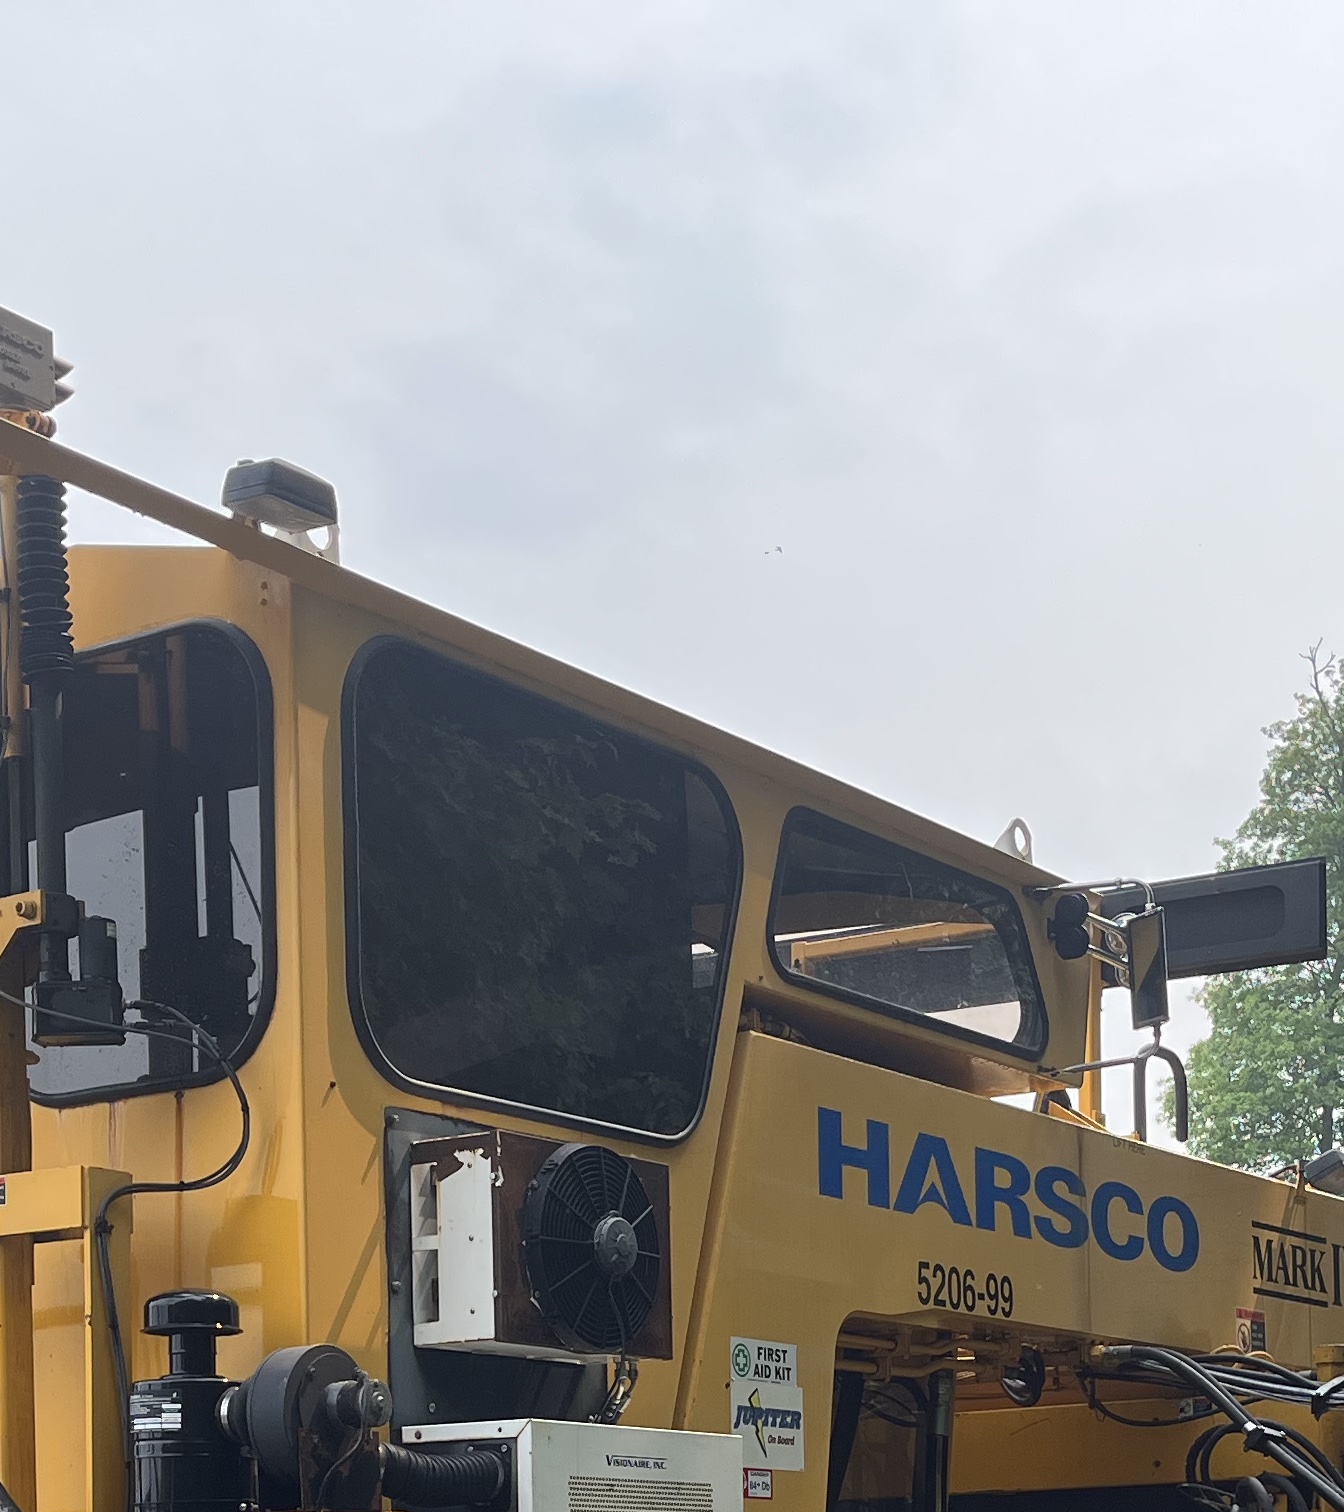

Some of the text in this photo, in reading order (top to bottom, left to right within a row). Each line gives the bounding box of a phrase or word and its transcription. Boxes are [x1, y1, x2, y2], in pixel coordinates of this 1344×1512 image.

[817, 1106, 1200, 1272] HARSCO
[1251, 1234, 1329, 1294] MARK
[917, 1260, 1014, 1319] 5206-99
[757, 1345, 788, 1364] FIRST
[752, 1363, 792, 1381] AID KIT
[733, 1404, 802, 1430] JUPITER
[767, 1434, 795, 1446] On Board
